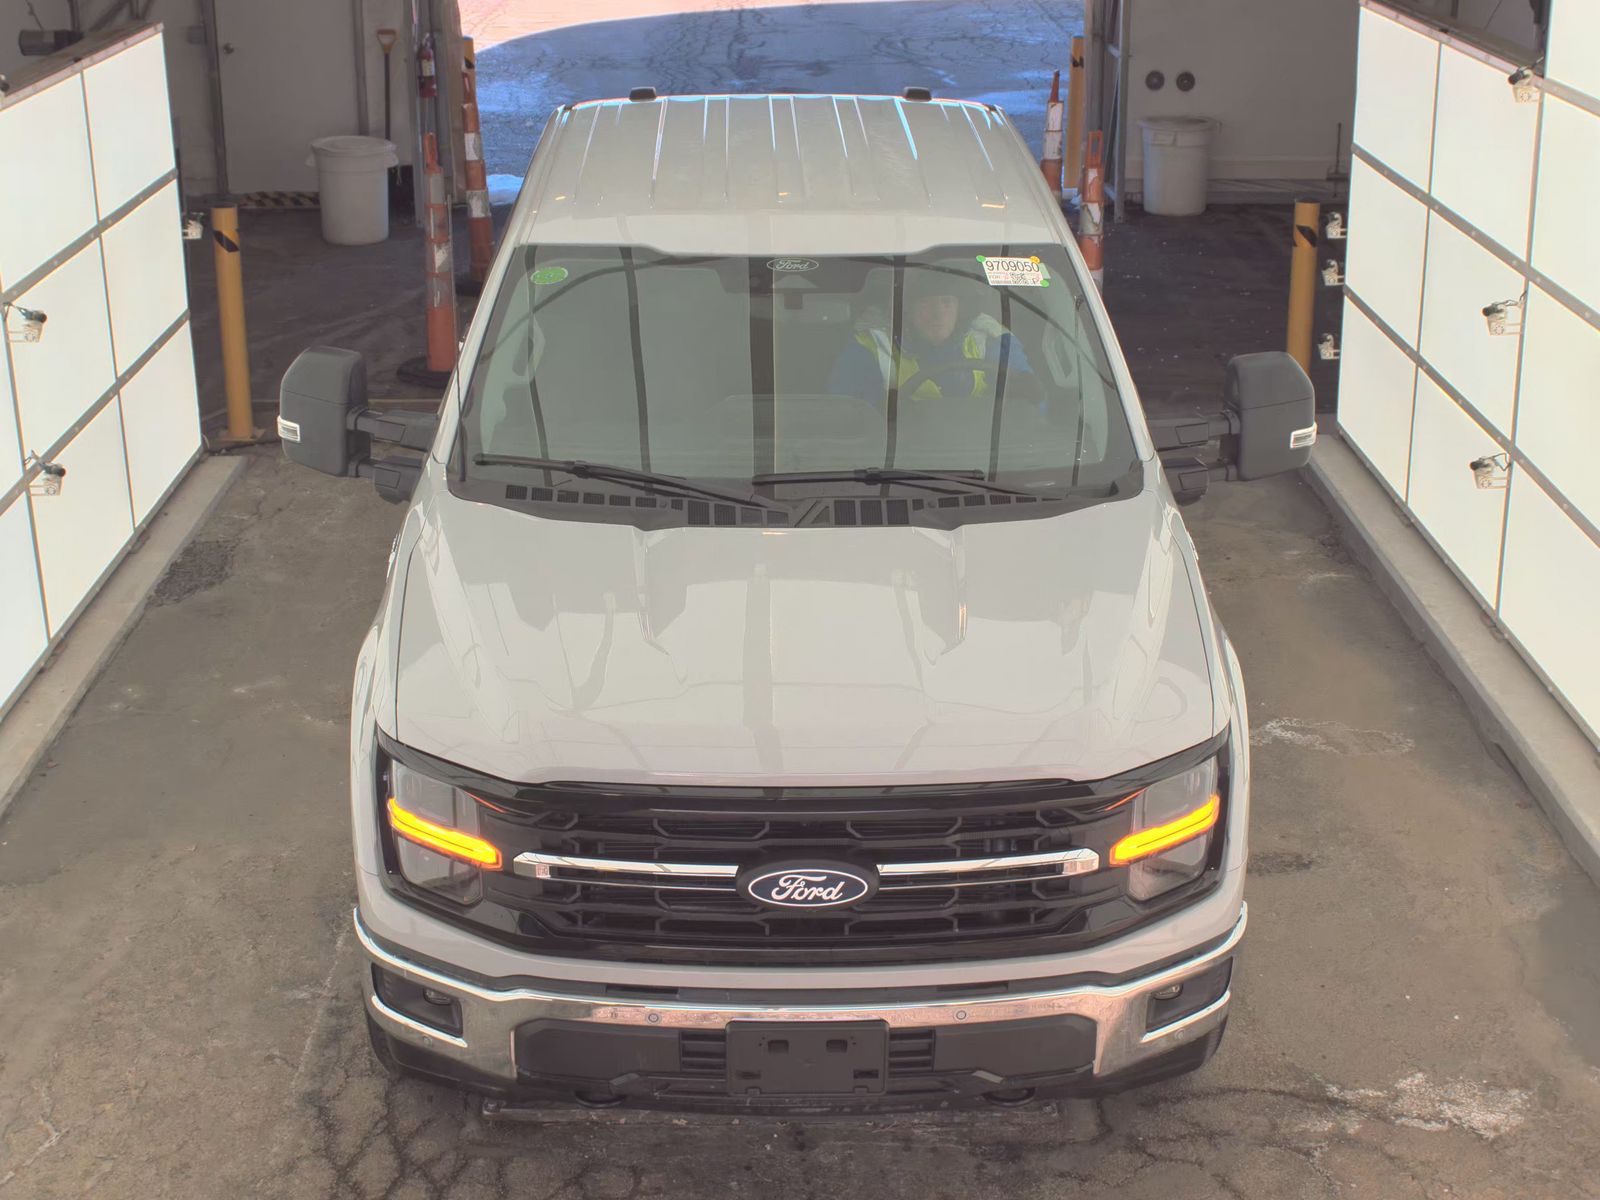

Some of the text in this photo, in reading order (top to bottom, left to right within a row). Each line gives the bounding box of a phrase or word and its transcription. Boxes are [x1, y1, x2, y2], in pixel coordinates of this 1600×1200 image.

[775, 259, 810, 270] Ford
[985, 260, 1040, 272] 9709050
[771, 874, 846, 900] Ford
